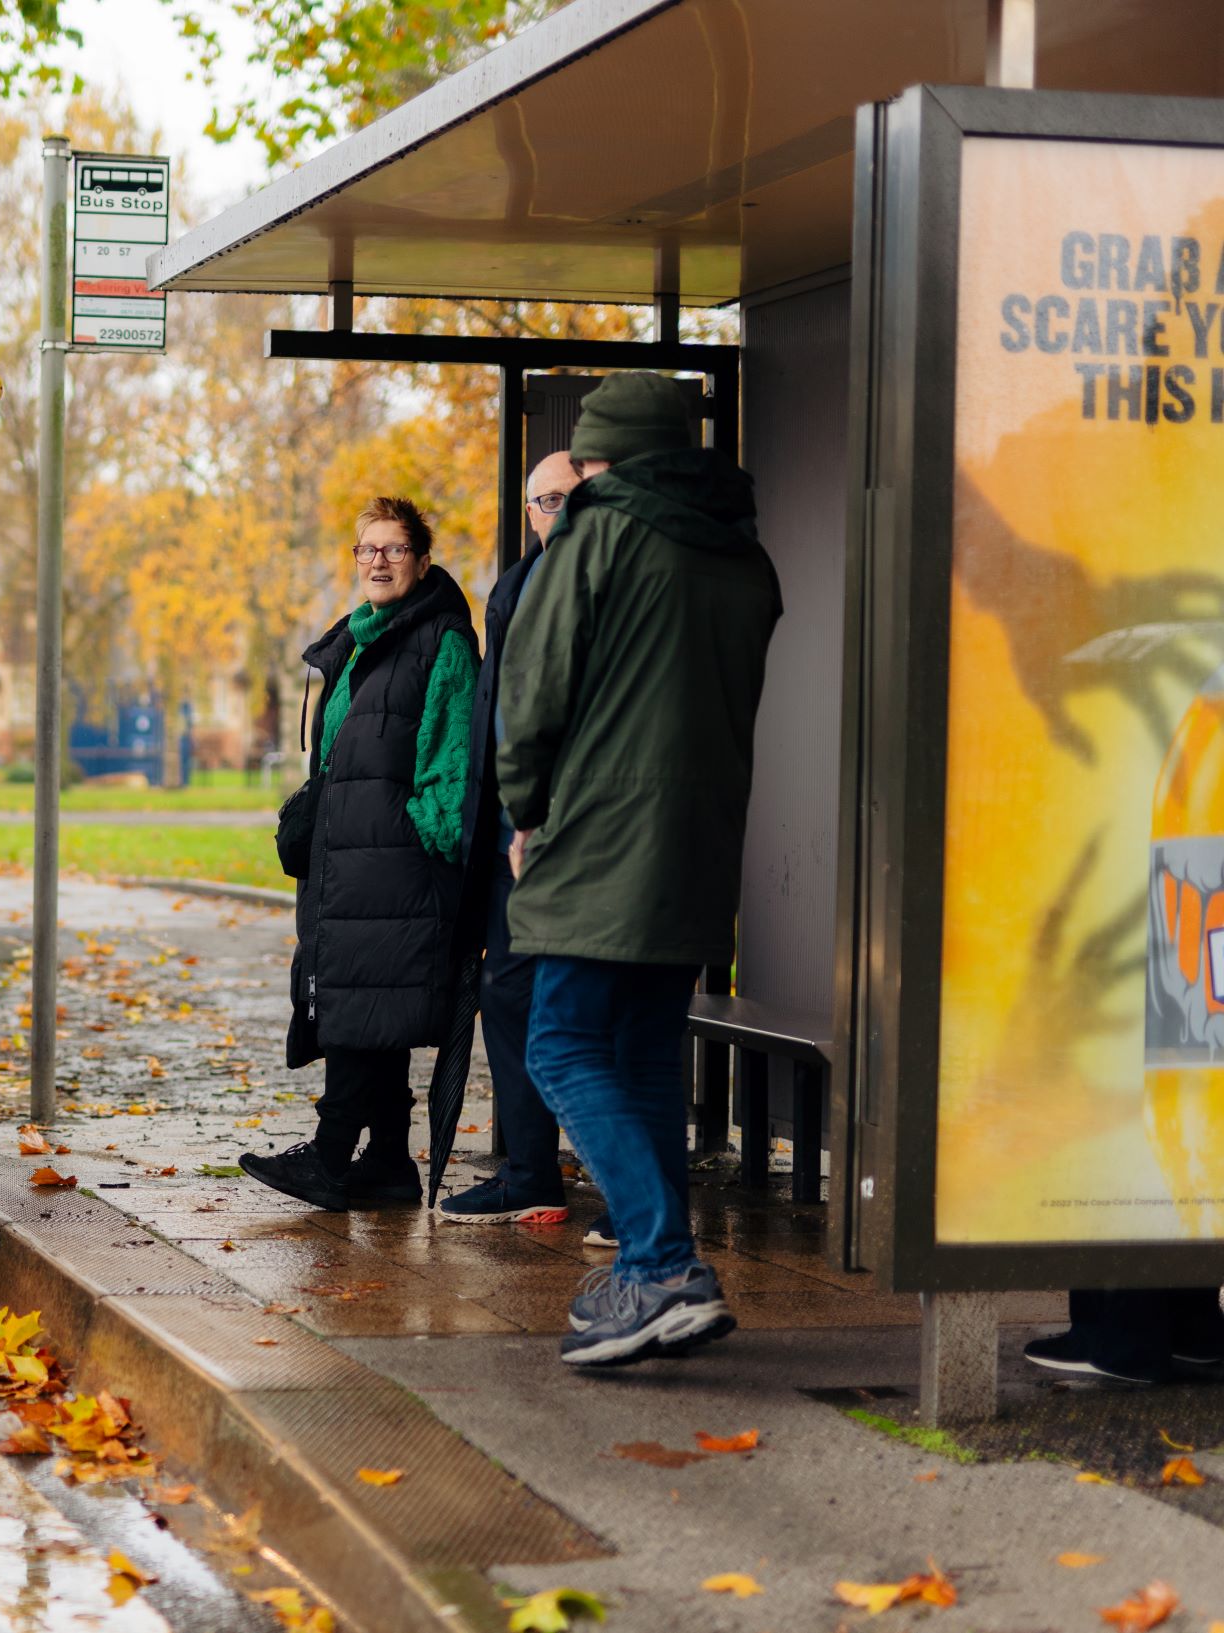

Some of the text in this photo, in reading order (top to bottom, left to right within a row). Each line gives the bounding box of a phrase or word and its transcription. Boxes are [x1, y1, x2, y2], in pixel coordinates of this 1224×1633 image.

[80, 195, 163, 212] Bus Stop
[97, 246, 110, 256] 20
[119, 247, 131, 257] 57
[1061, 230, 1201, 297] GRAB
[99, 328, 162, 341] 22900572
[1000, 293, 1224, 359] SCARE Y
[1075, 363, 1196, 425] THIS
